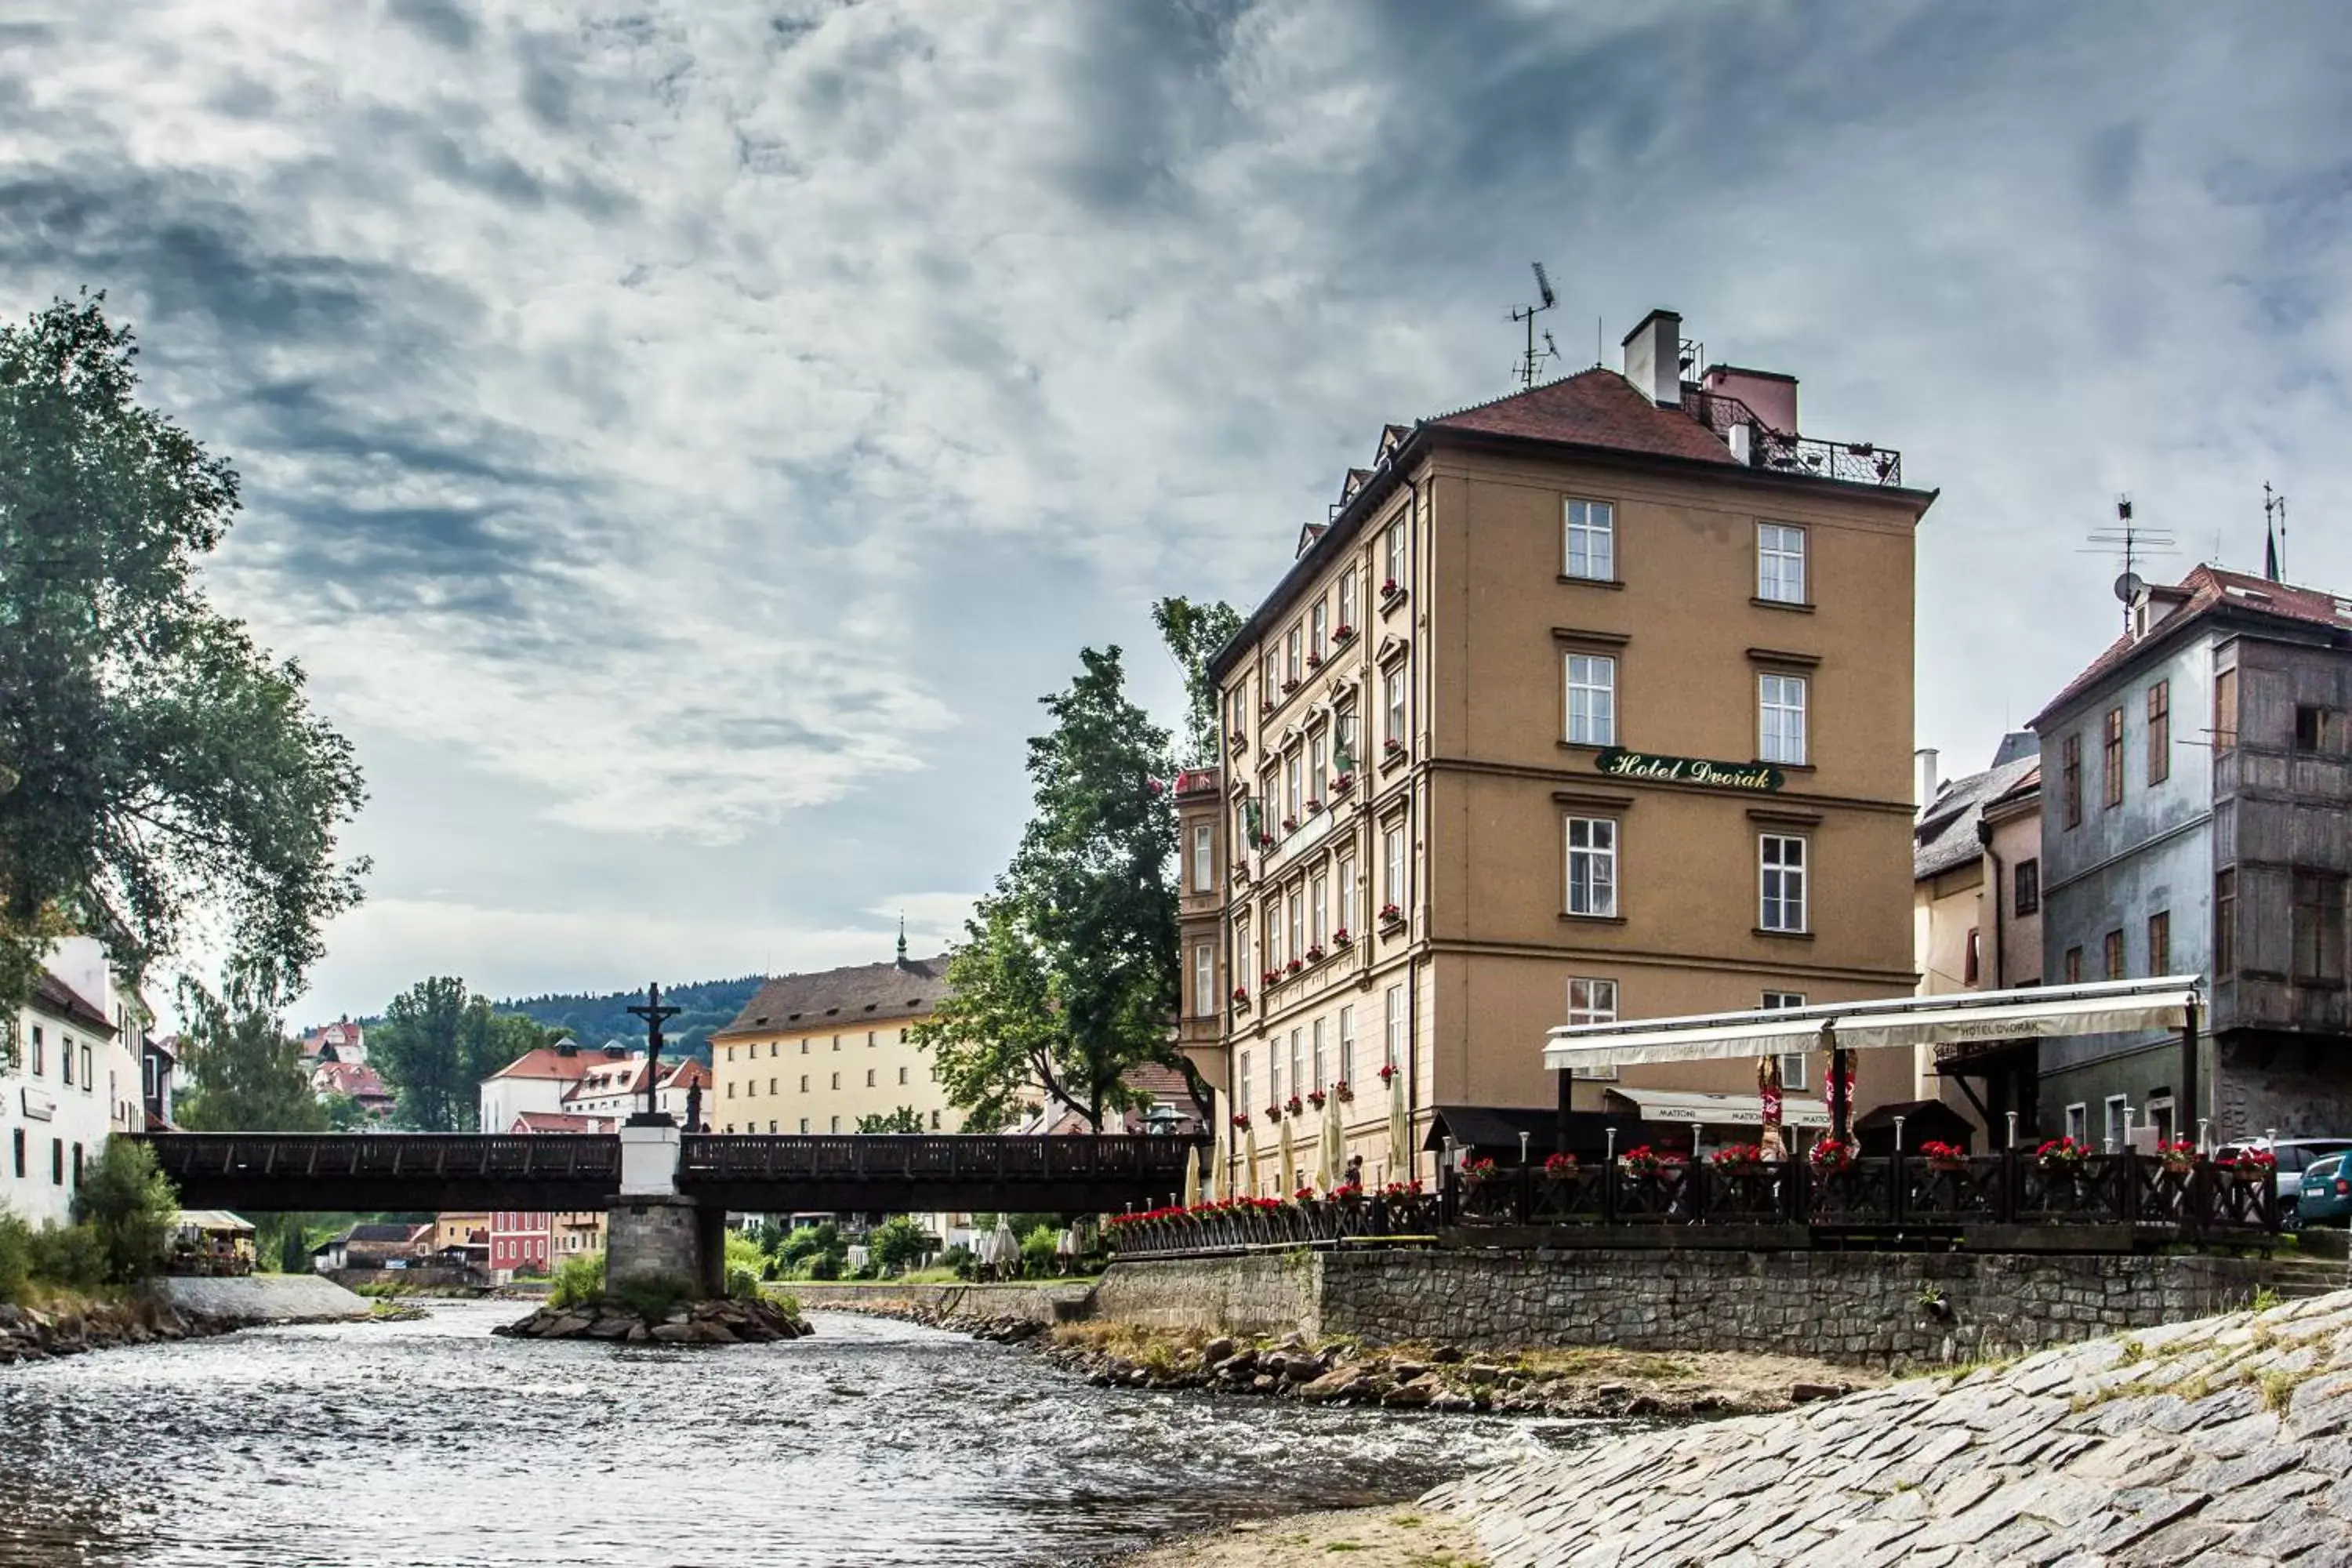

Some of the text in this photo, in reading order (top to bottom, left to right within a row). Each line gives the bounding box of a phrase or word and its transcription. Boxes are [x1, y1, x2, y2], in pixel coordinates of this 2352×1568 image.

[1610, 754, 1769, 788] Hotel Dvořák
[1962, 1024, 1994, 1036] HOTEL
[1659, 1109, 1696, 1118] MATTONI
